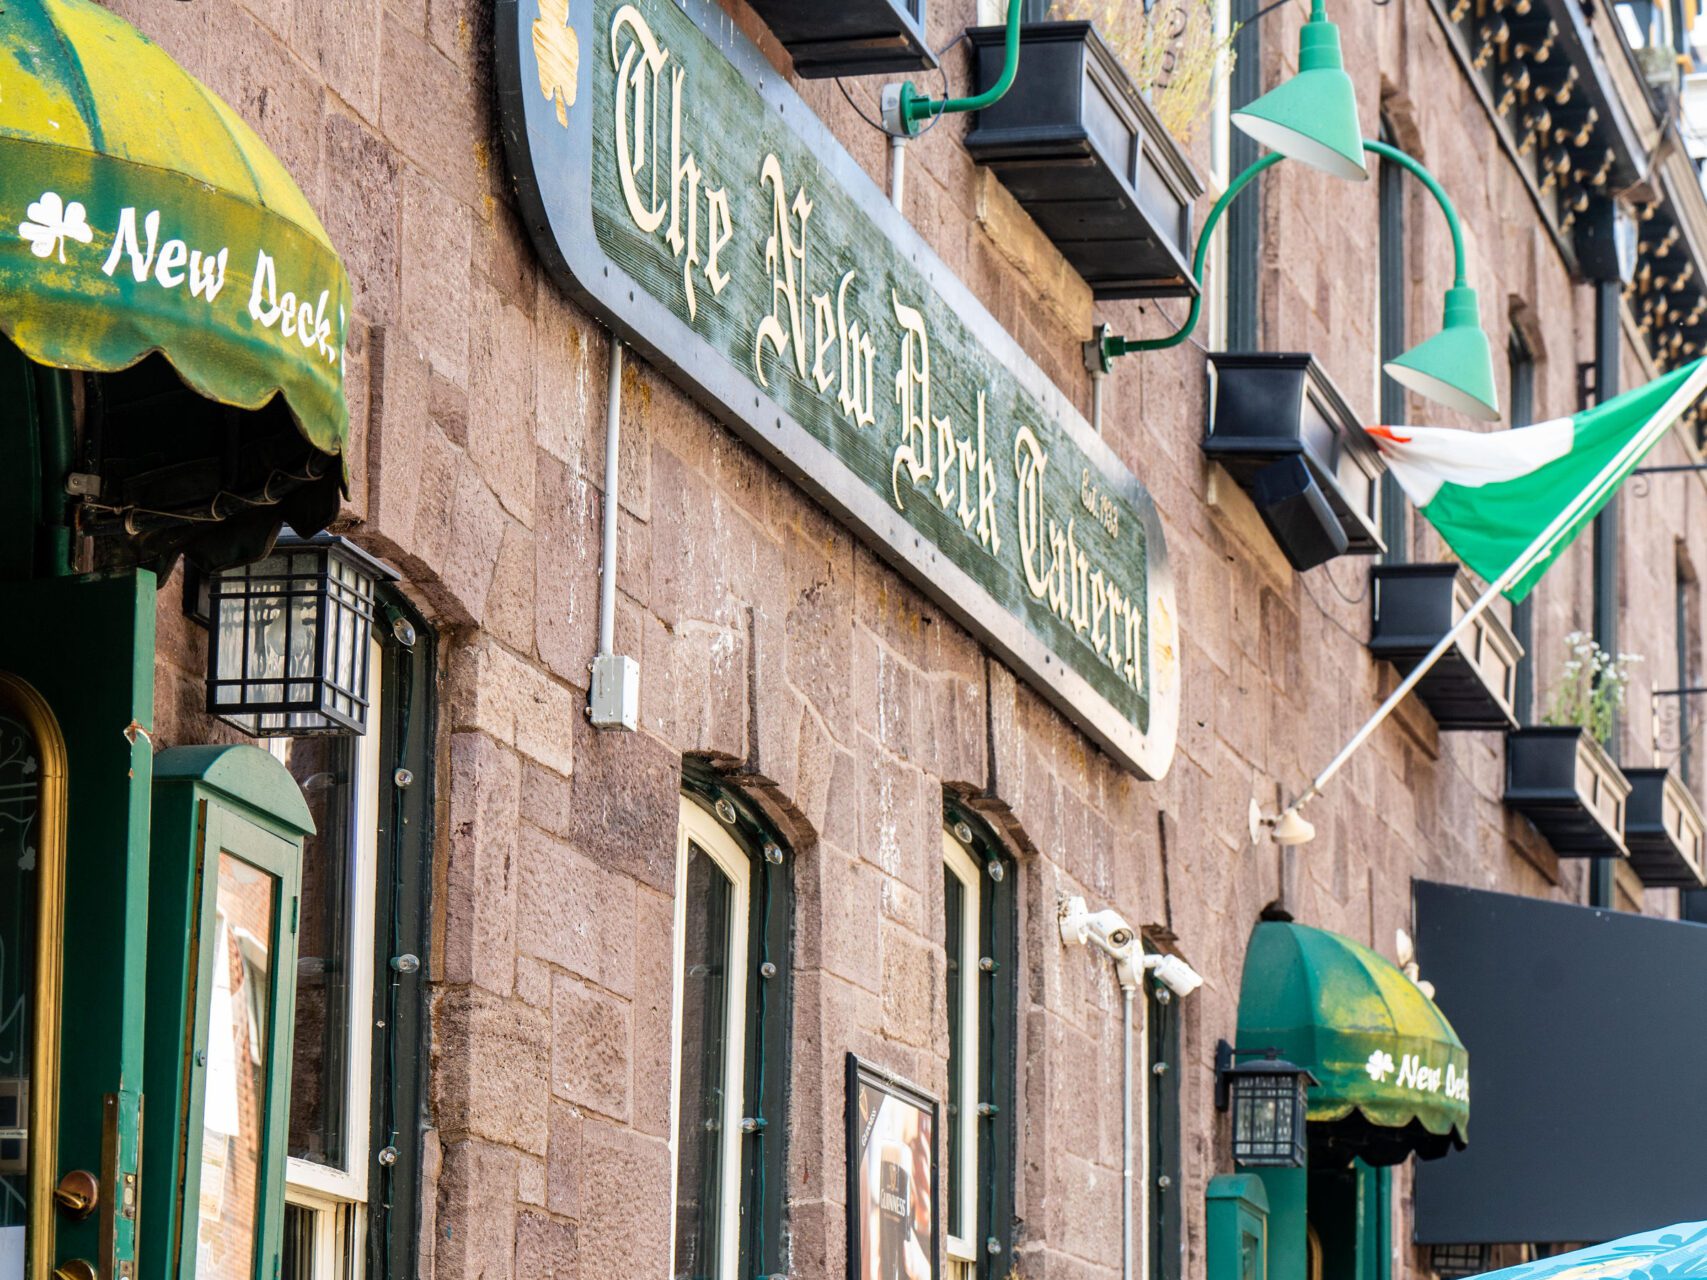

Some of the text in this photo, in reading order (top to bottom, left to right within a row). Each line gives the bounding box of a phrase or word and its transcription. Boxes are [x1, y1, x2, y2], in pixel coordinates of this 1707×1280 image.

[101, 206, 336, 365] New Deck
[611, 4, 1143, 692] The New Deck Tavern
[1396, 1054, 1441, 1093] New
[880, 1188, 906, 1217] GUINNESS
